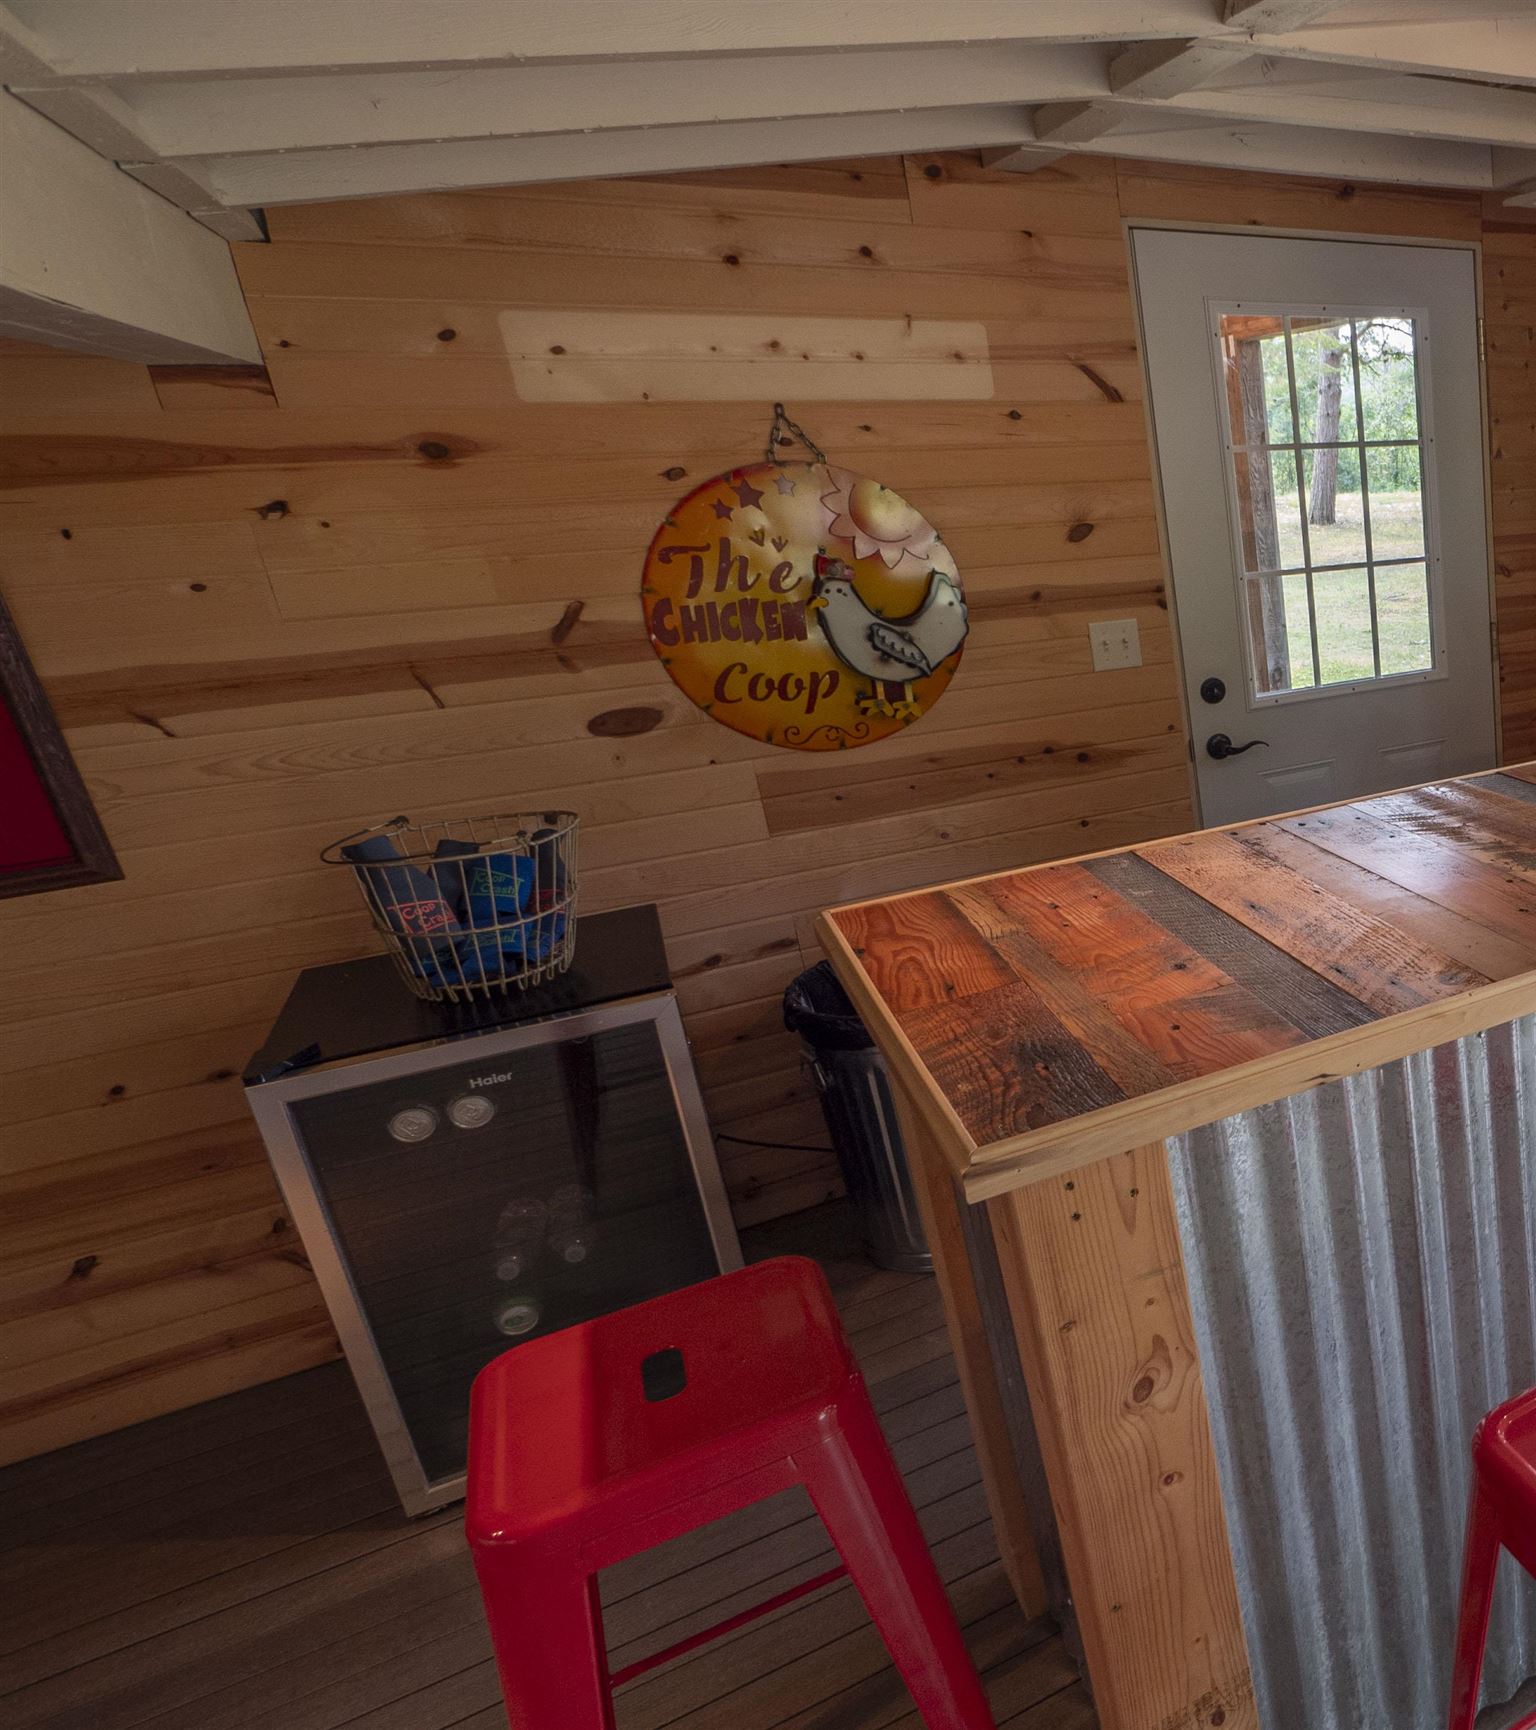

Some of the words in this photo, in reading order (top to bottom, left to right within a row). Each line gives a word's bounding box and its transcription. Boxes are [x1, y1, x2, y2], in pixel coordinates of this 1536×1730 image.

[658, 537, 802, 599] The
[651, 596, 809, 647] CHICKEN
[714, 662, 840, 715] Coop
[469, 1071, 513, 1089] Haier
